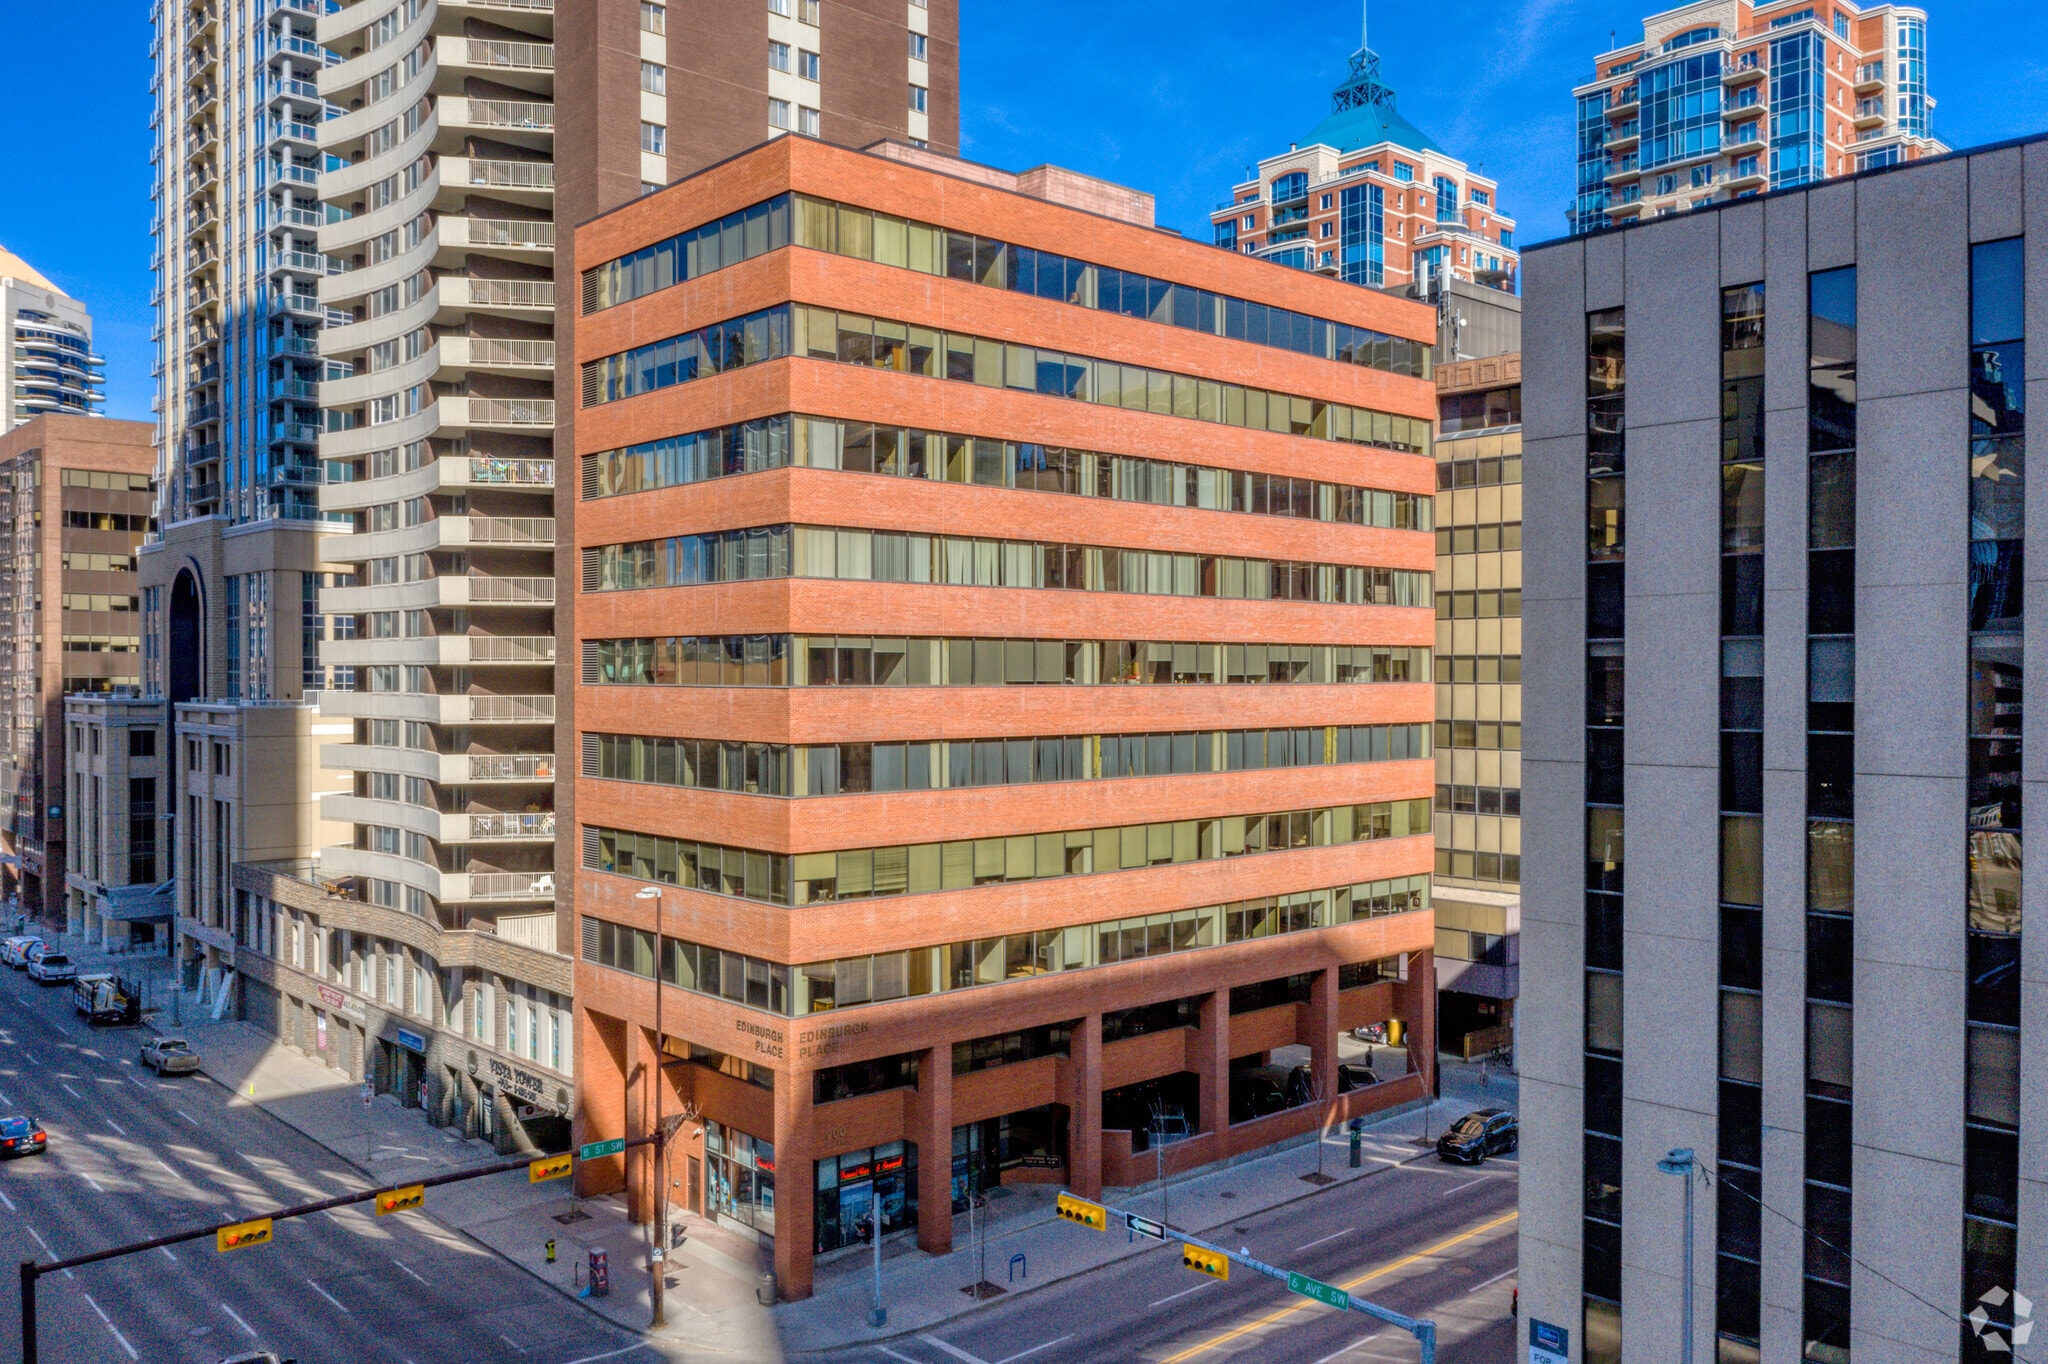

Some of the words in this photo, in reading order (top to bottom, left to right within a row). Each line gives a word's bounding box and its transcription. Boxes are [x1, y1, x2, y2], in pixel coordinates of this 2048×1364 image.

[736, 1020, 783, 1044] EDINBURGH
[800, 1021, 868, 1044] EDINBURGH
[755, 1041, 783, 1059] PLACE
[800, 1041, 839, 1059] PLACE
[583, 1147, 589, 1157] 8
[595, 1143, 606, 1155] ST
[611, 1140, 623, 1151] SW
[1291, 1277, 1299, 1289] 6
[1304, 1281, 1323, 1298] AVE
[1330, 1290, 1346, 1306] SW
[1534, 1353, 1552, 1364] FOR
